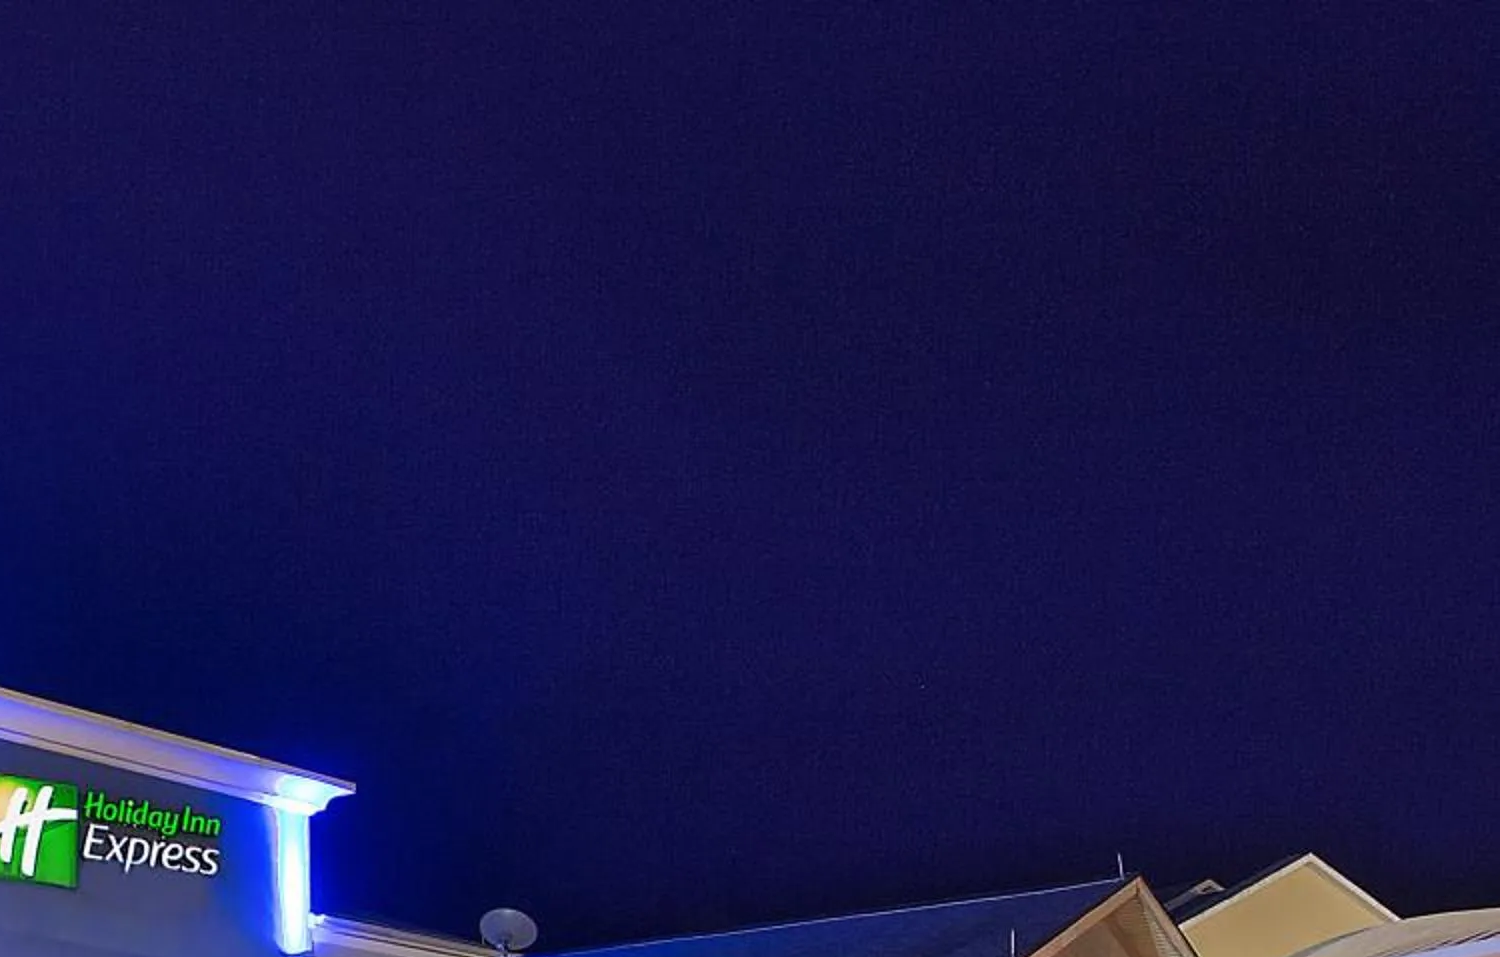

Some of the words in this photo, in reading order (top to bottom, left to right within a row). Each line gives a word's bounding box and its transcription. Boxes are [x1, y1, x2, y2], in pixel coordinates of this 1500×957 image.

[84, 792, 180, 834] Holiday
[183, 806, 220, 836] Inn
[83, 824, 220, 875] Express
